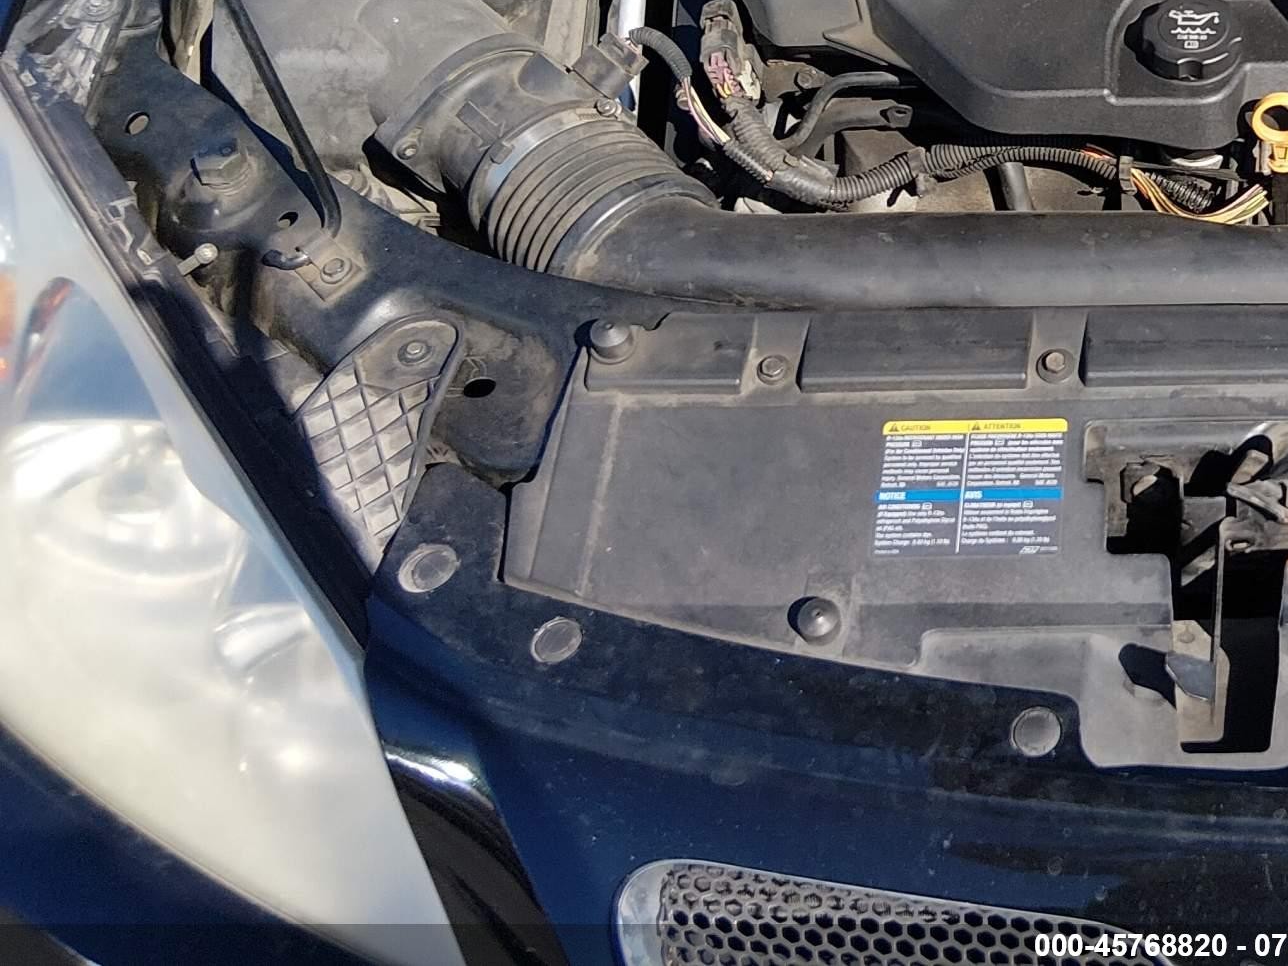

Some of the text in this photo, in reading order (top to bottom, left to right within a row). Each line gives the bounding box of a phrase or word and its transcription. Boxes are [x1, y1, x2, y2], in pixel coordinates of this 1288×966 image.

[901, 424, 931, 432] CAUTION
[984, 422, 1021, 430] ATTENTION
[879, 491, 906, 500] NOTICE
[964, 490, 983, 499] AVIS
